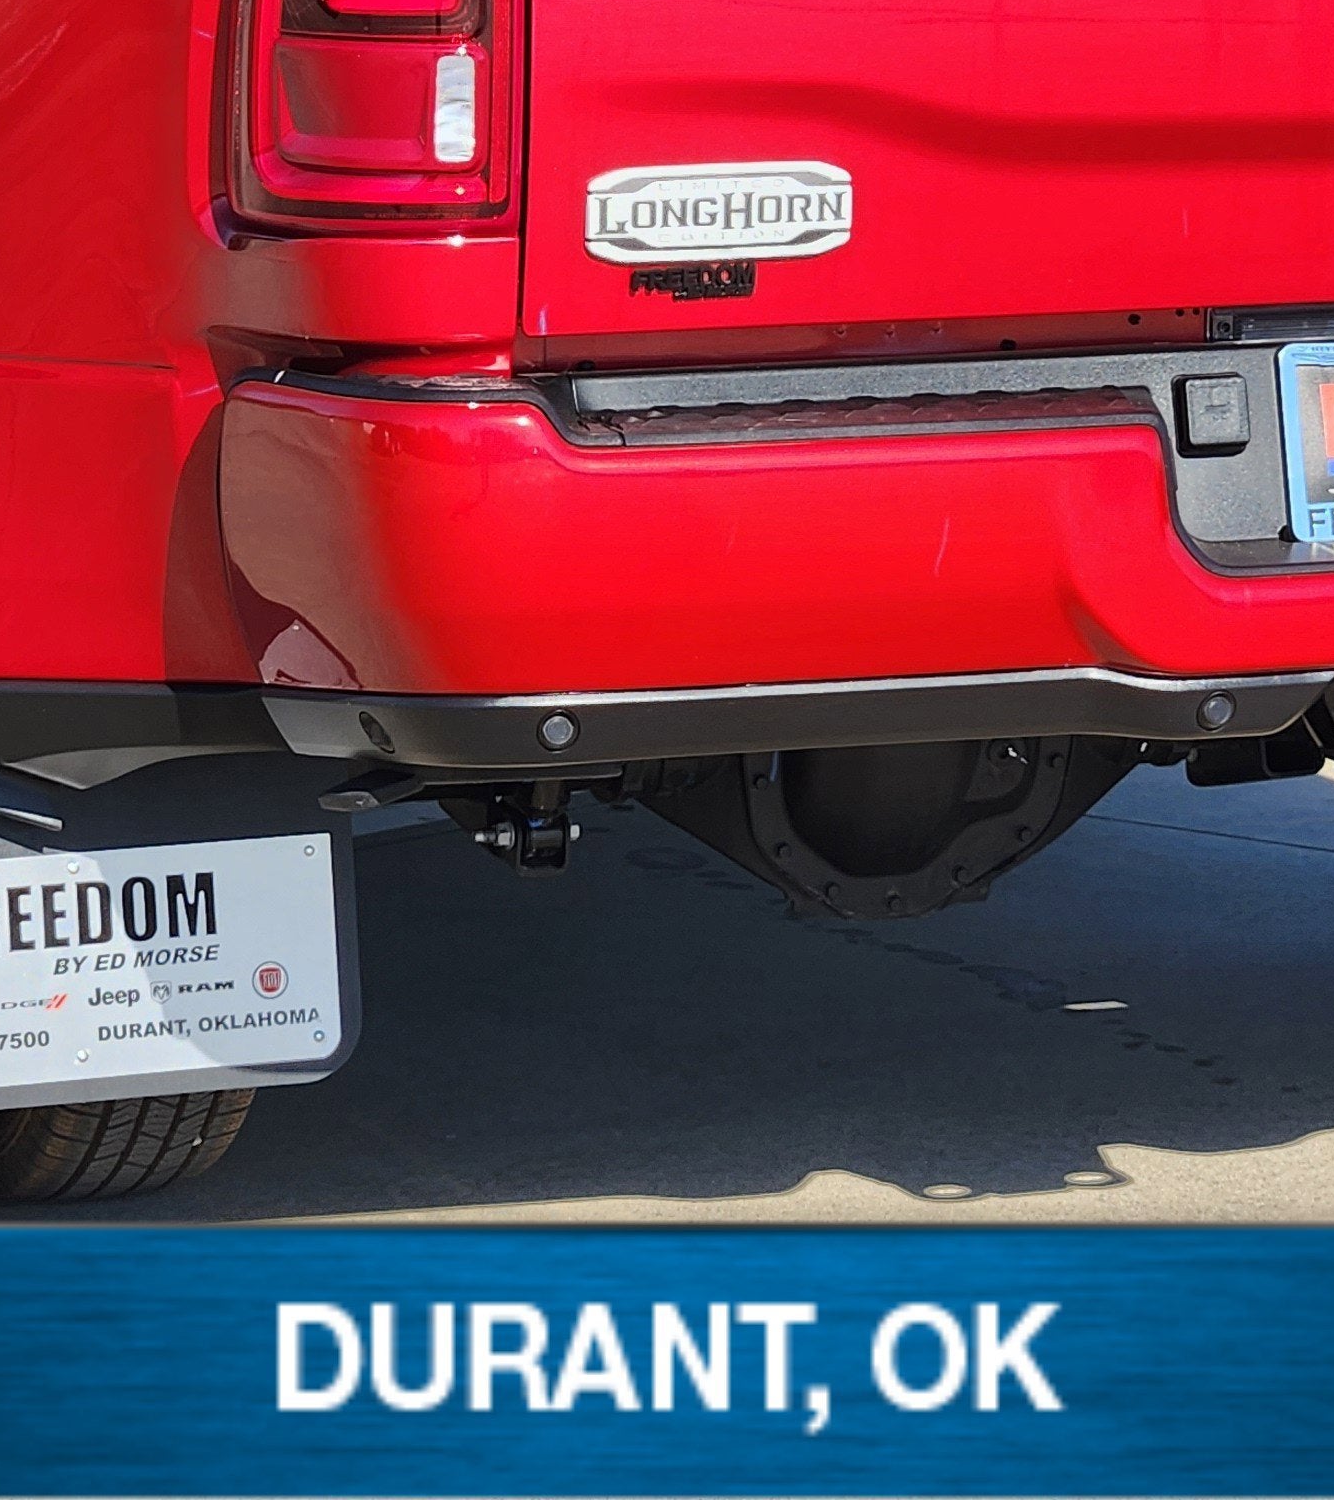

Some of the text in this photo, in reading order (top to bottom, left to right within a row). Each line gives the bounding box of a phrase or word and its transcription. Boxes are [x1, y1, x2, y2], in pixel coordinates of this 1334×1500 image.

[53, 944, 220, 976] BY ED MORSE
[88, 987, 141, 1007] Jeep
[178, 980, 235, 994] RAM
[98, 1007, 321, 1042] DURANT, OKLAHOMA
